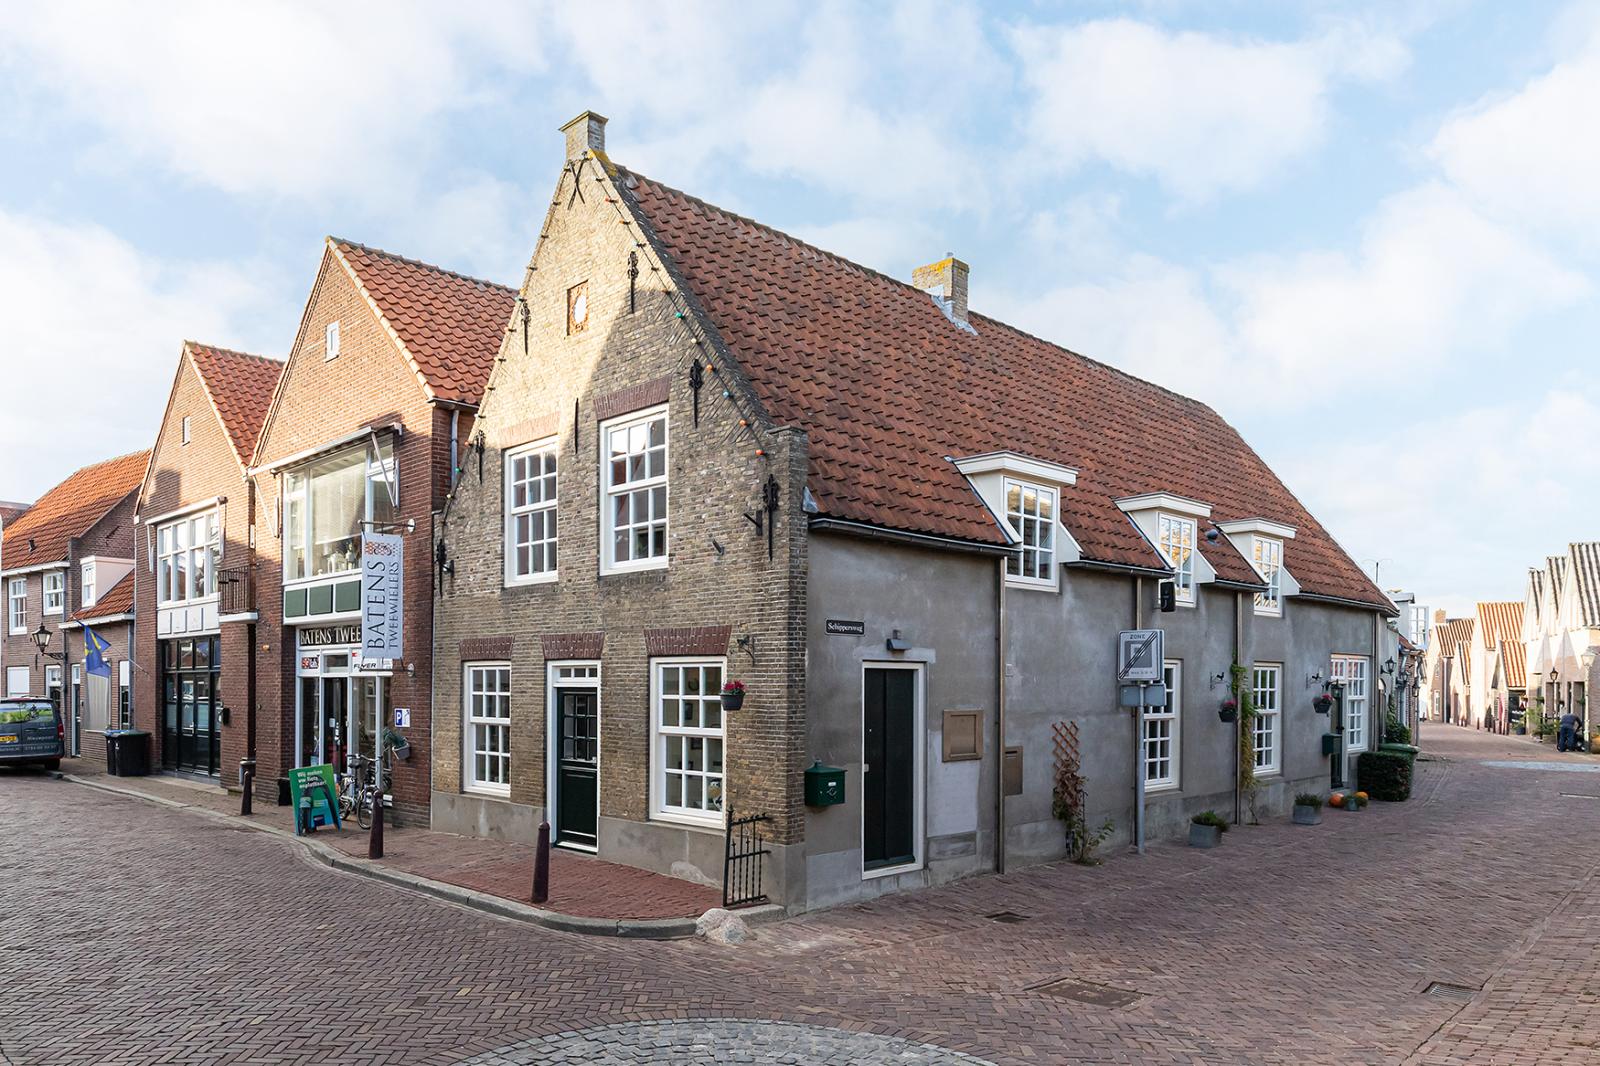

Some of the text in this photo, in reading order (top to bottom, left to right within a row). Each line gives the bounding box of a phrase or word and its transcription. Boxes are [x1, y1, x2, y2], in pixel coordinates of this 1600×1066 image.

[367, 561, 385, 648] BATENS
[389, 562, 399, 649] TWEEWIELERS
[300, 628, 331, 645] BATENS
[396, 711, 402, 724] P
